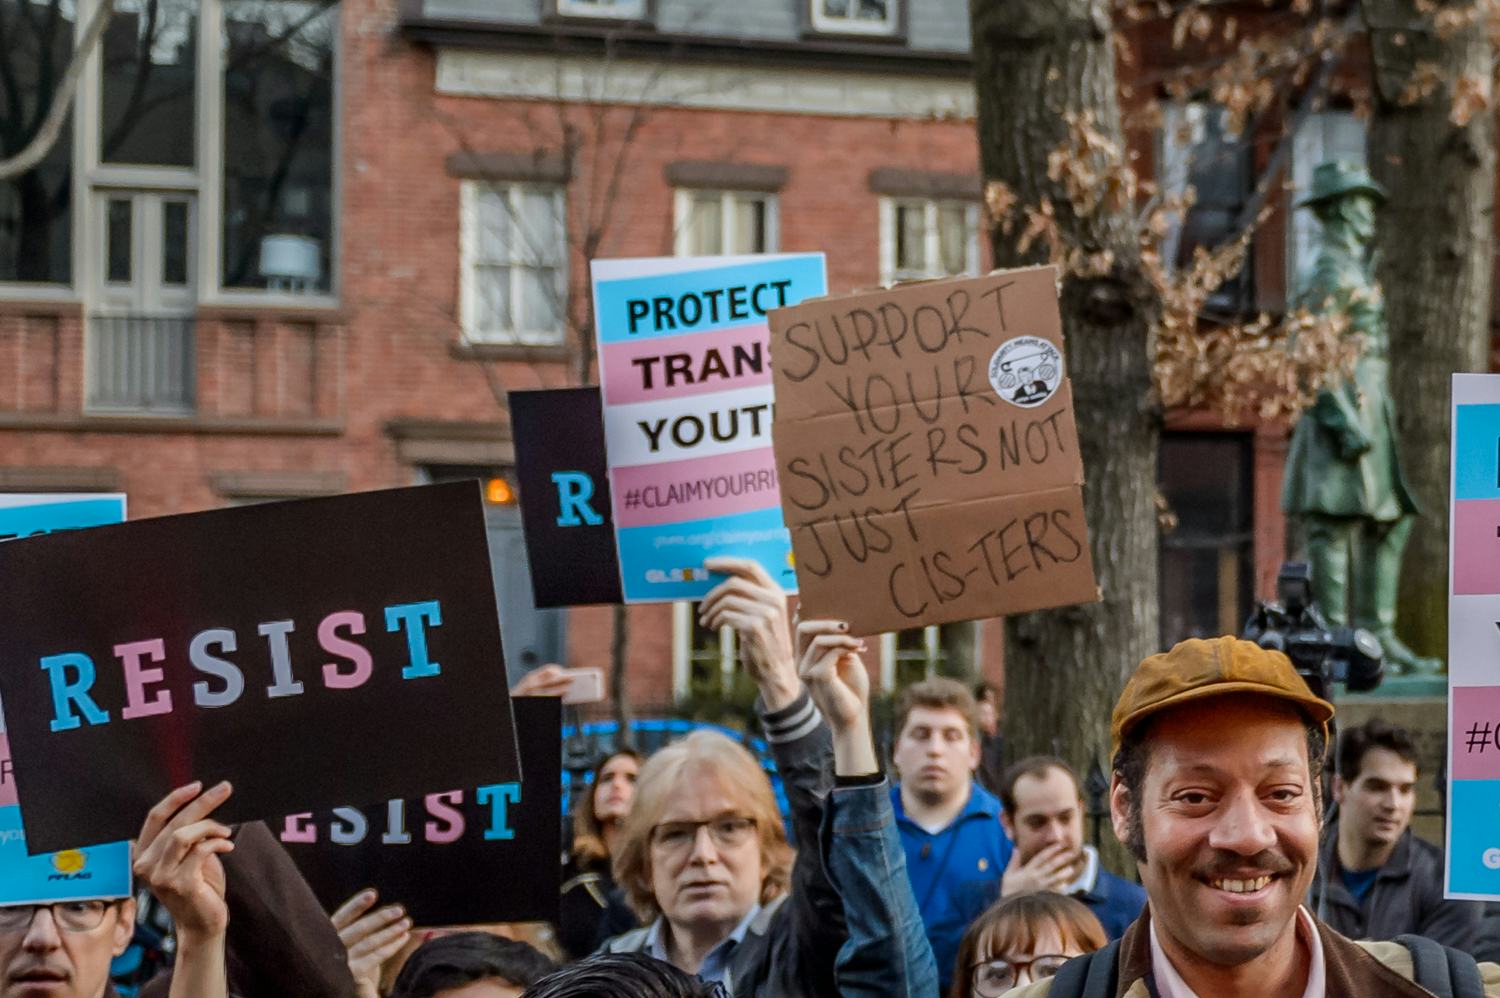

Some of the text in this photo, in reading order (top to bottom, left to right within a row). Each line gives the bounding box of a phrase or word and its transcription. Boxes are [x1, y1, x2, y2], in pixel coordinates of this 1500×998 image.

[626, 280, 792, 334] PROTECT
[783, 281, 1016, 383] SUPPORT
[631, 342, 771, 390] TRAN
[825, 355, 996, 435] YOUR
[637, 404, 775, 452] YOUT
[787, 408, 1066, 510] SISTERS NOT
[625, 470, 775, 510] #CLAIMYOURRI
[803, 488, 922, 579] JUST
[889, 509, 1082, 618] CIS-TERS
[40, 601, 442, 733] RESIST
[280, 782, 521, 845] ESIST
